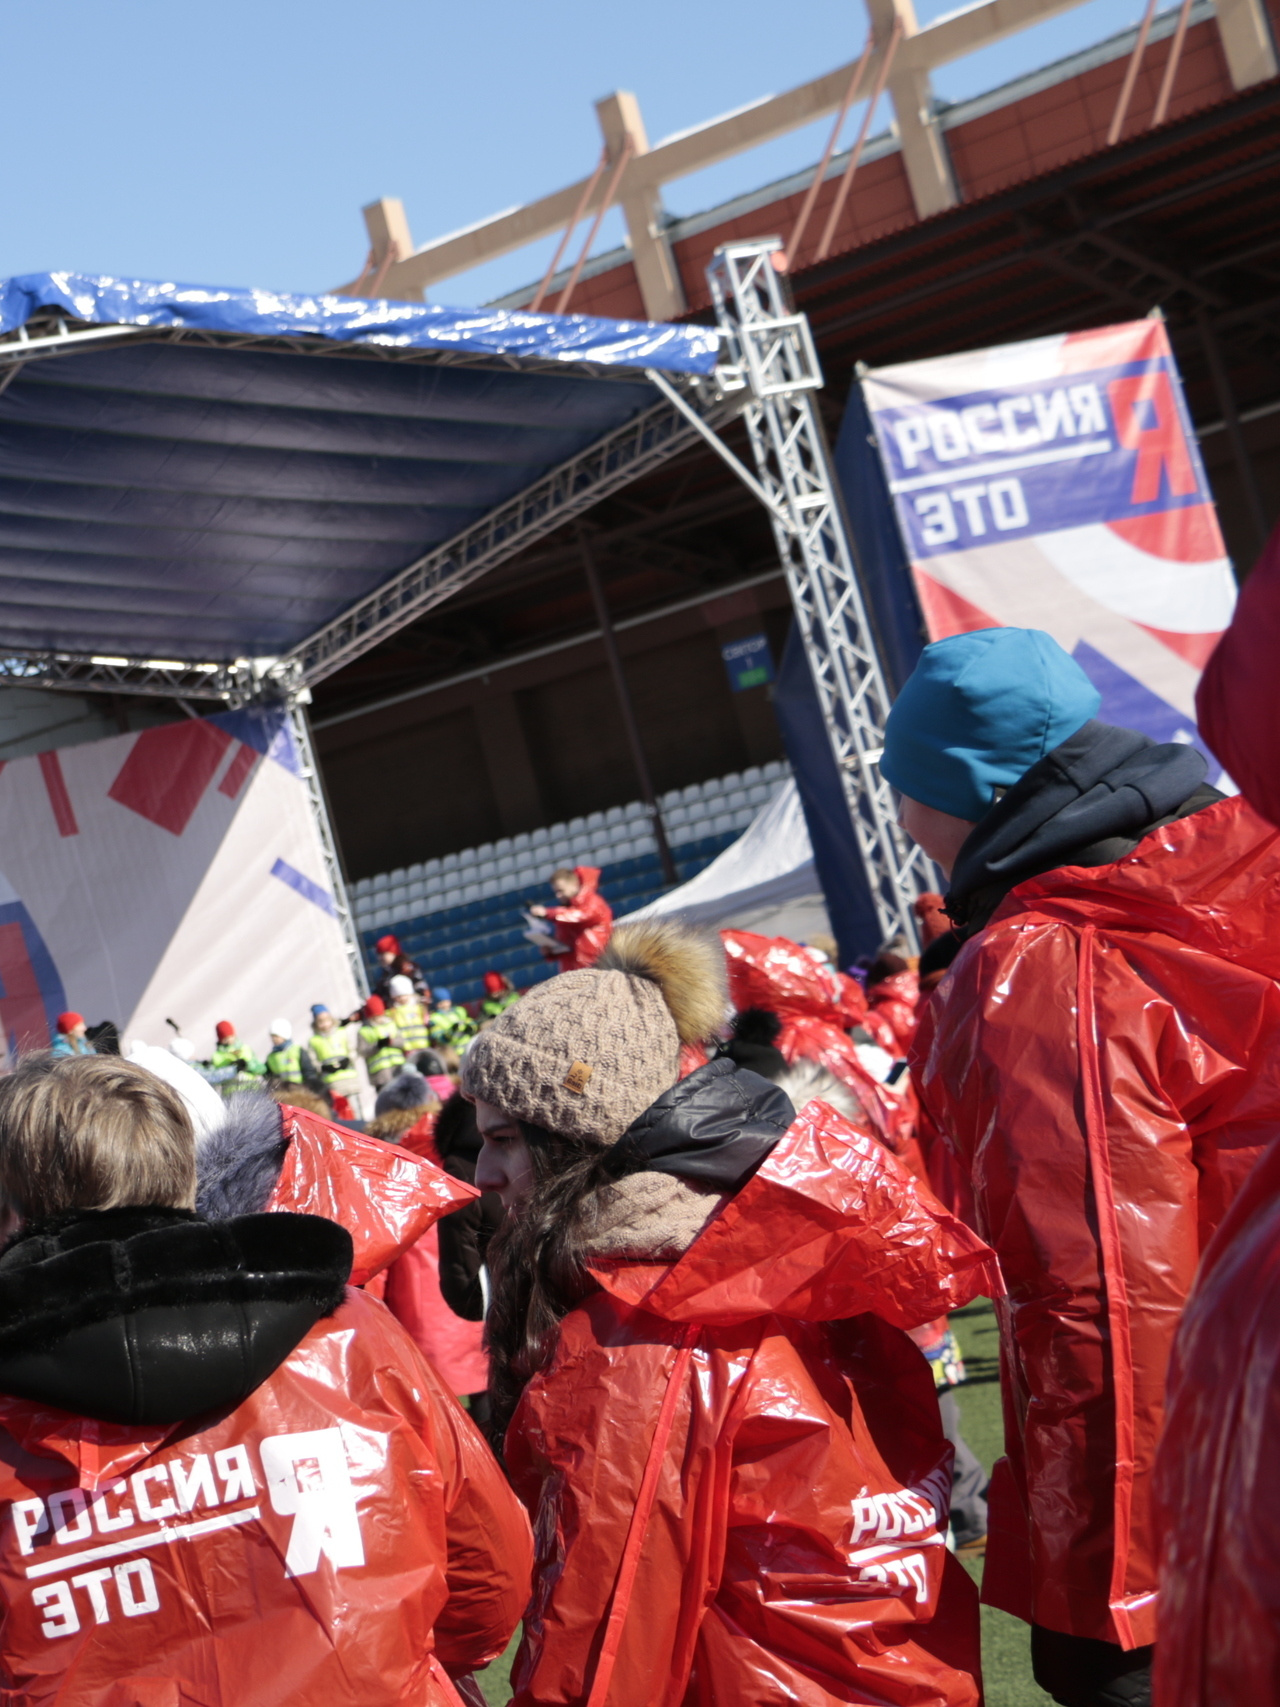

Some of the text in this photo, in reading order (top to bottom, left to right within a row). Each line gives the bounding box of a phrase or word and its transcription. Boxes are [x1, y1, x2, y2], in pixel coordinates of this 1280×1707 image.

[894, 382, 1107, 469] РОССИЯ
[1107, 371, 1198, 504] Я
[915, 478, 1029, 546] ЭТО
[12, 1443, 258, 1556] РОССИЯ
[259, 1427, 366, 1579] Я
[31, 1557, 160, 1640] ЭТО
